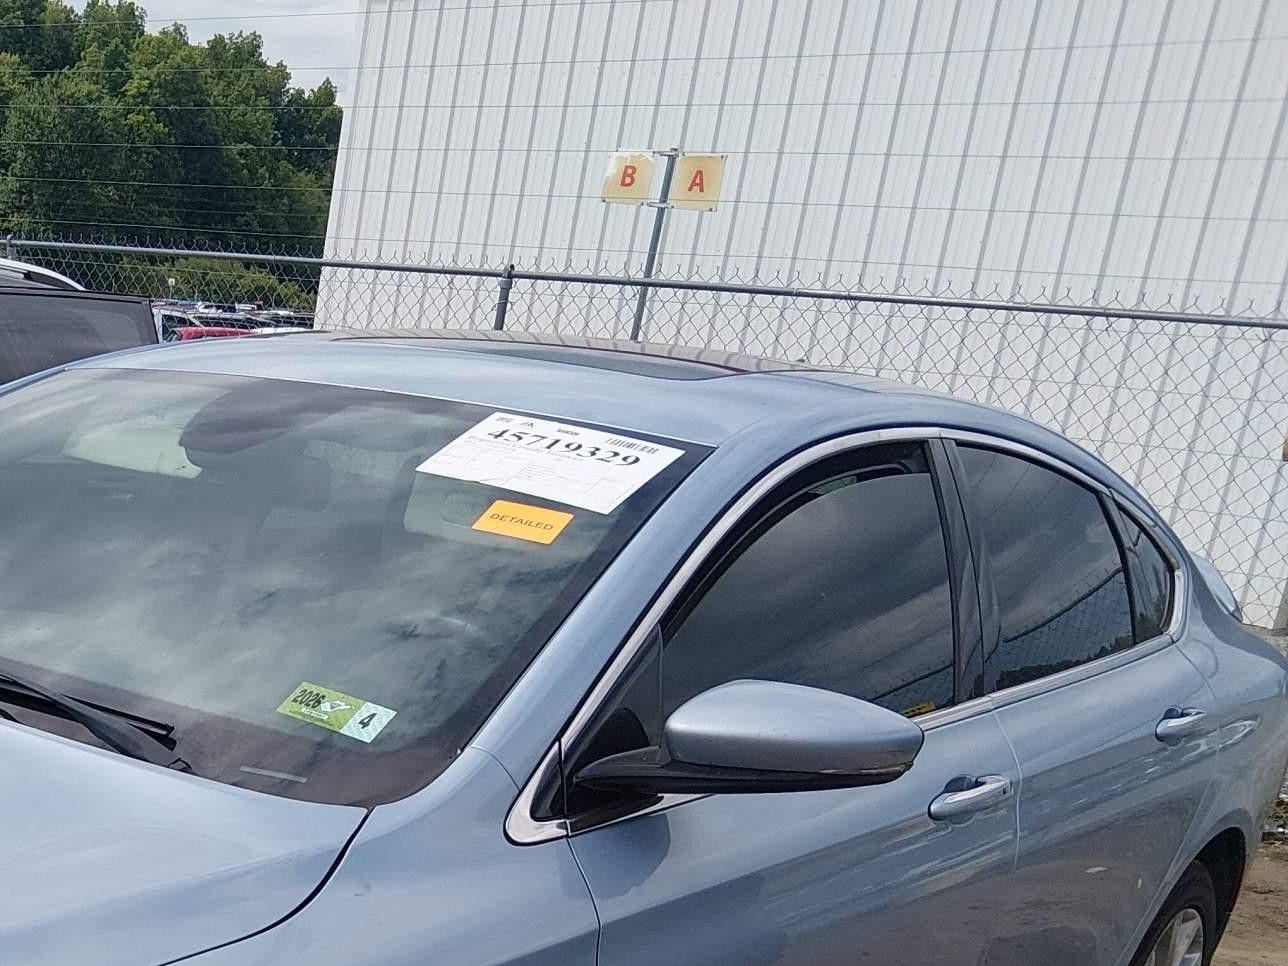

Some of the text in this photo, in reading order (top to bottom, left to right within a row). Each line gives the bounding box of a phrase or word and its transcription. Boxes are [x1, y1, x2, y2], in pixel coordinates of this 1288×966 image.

[619, 164, 637, 188] B
[687, 169, 705, 193] A
[487, 428, 641, 467] 45719329
[488, 512, 554, 532] DETAILED
[292, 688, 326, 709] 2026
[358, 711, 378, 730] 4
